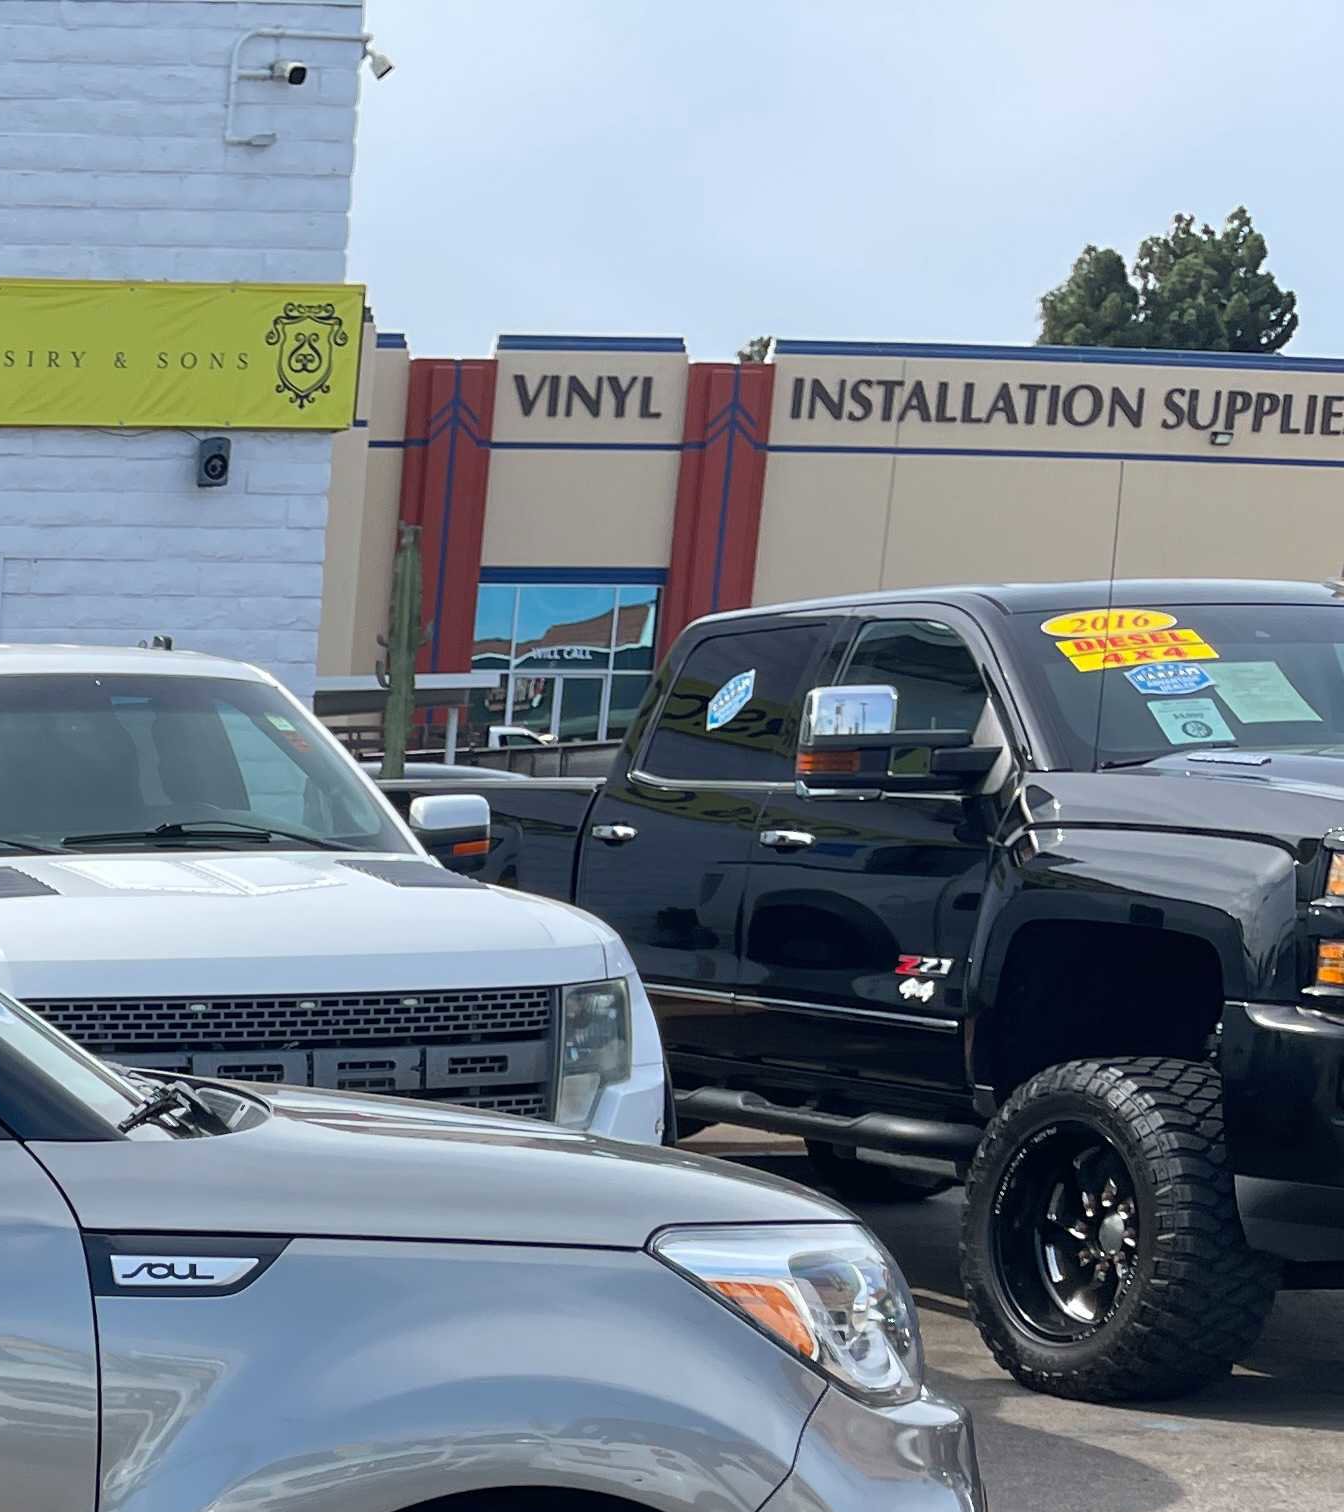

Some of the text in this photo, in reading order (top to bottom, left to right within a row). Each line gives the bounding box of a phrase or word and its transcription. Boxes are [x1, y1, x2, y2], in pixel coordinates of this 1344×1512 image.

[3, 350, 250, 370] SIRY & SONS
[512, 373, 662, 420] VINYL
[789, 376, 1344, 436] INSTALLATION SUPPLIE
[1070, 614, 1150, 634] 2016
[1072, 631, 1190, 652] DIESEL
[895, 954, 955, 978] Z71
[121, 1262, 215, 1280] SOUL
